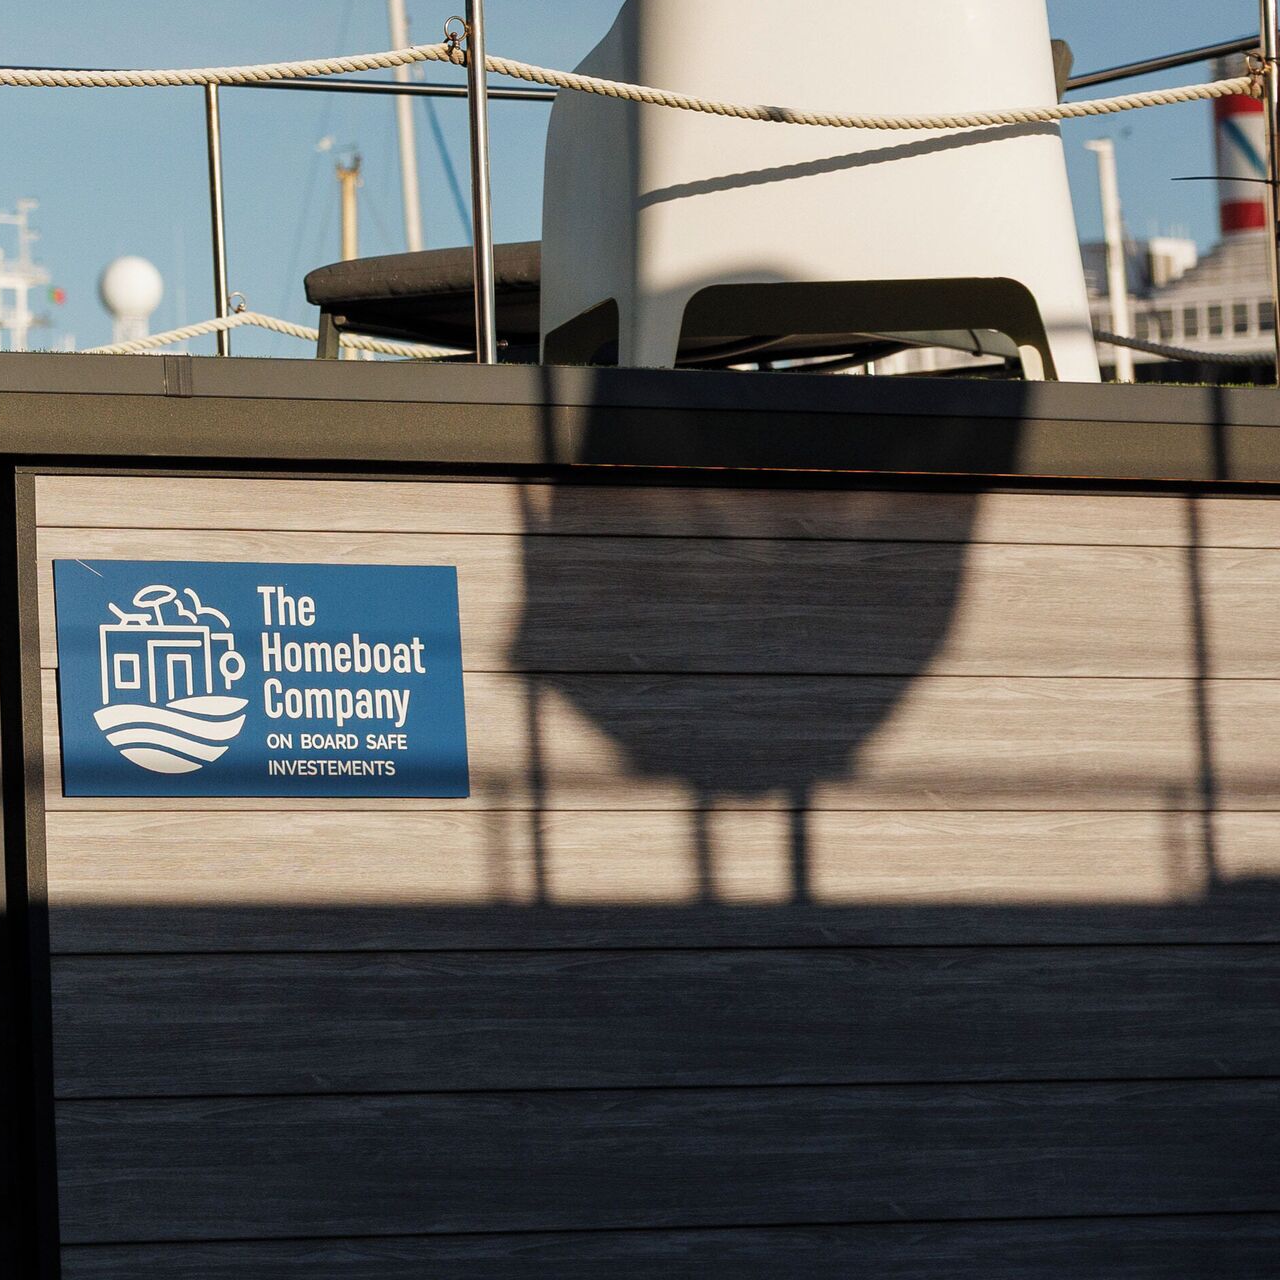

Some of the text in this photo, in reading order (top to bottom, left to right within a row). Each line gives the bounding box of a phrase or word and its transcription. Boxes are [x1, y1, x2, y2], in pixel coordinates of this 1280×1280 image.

[258, 586, 316, 626] The
[261, 632, 426, 674] Homeboat
[264, 678, 410, 728] Company
[266, 733, 408, 750] ON BOARD SAFE
[268, 759, 396, 776] INVESTEMENTS
